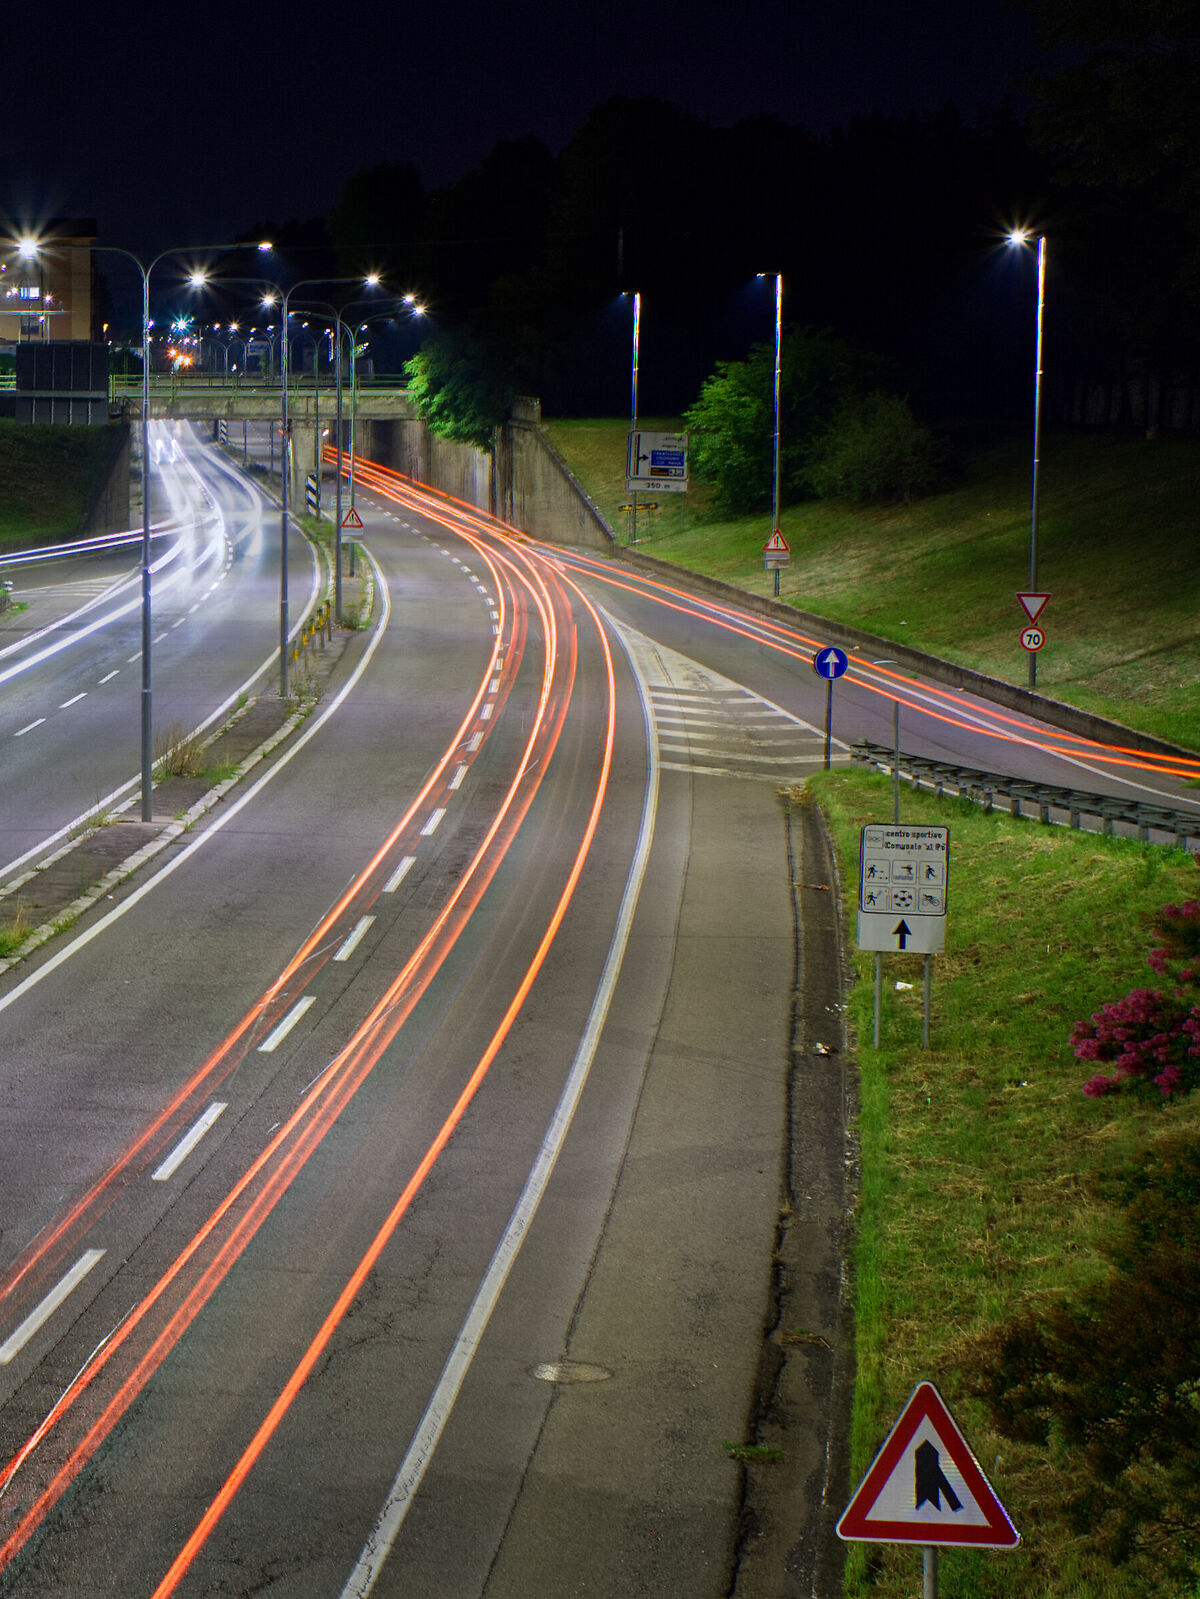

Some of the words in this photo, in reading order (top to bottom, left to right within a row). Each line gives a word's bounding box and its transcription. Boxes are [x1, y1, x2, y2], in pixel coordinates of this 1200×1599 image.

[1026, 634, 1041, 646] 70
[885, 830, 910, 838] centro
[911, 831, 943, 840] sportivo
